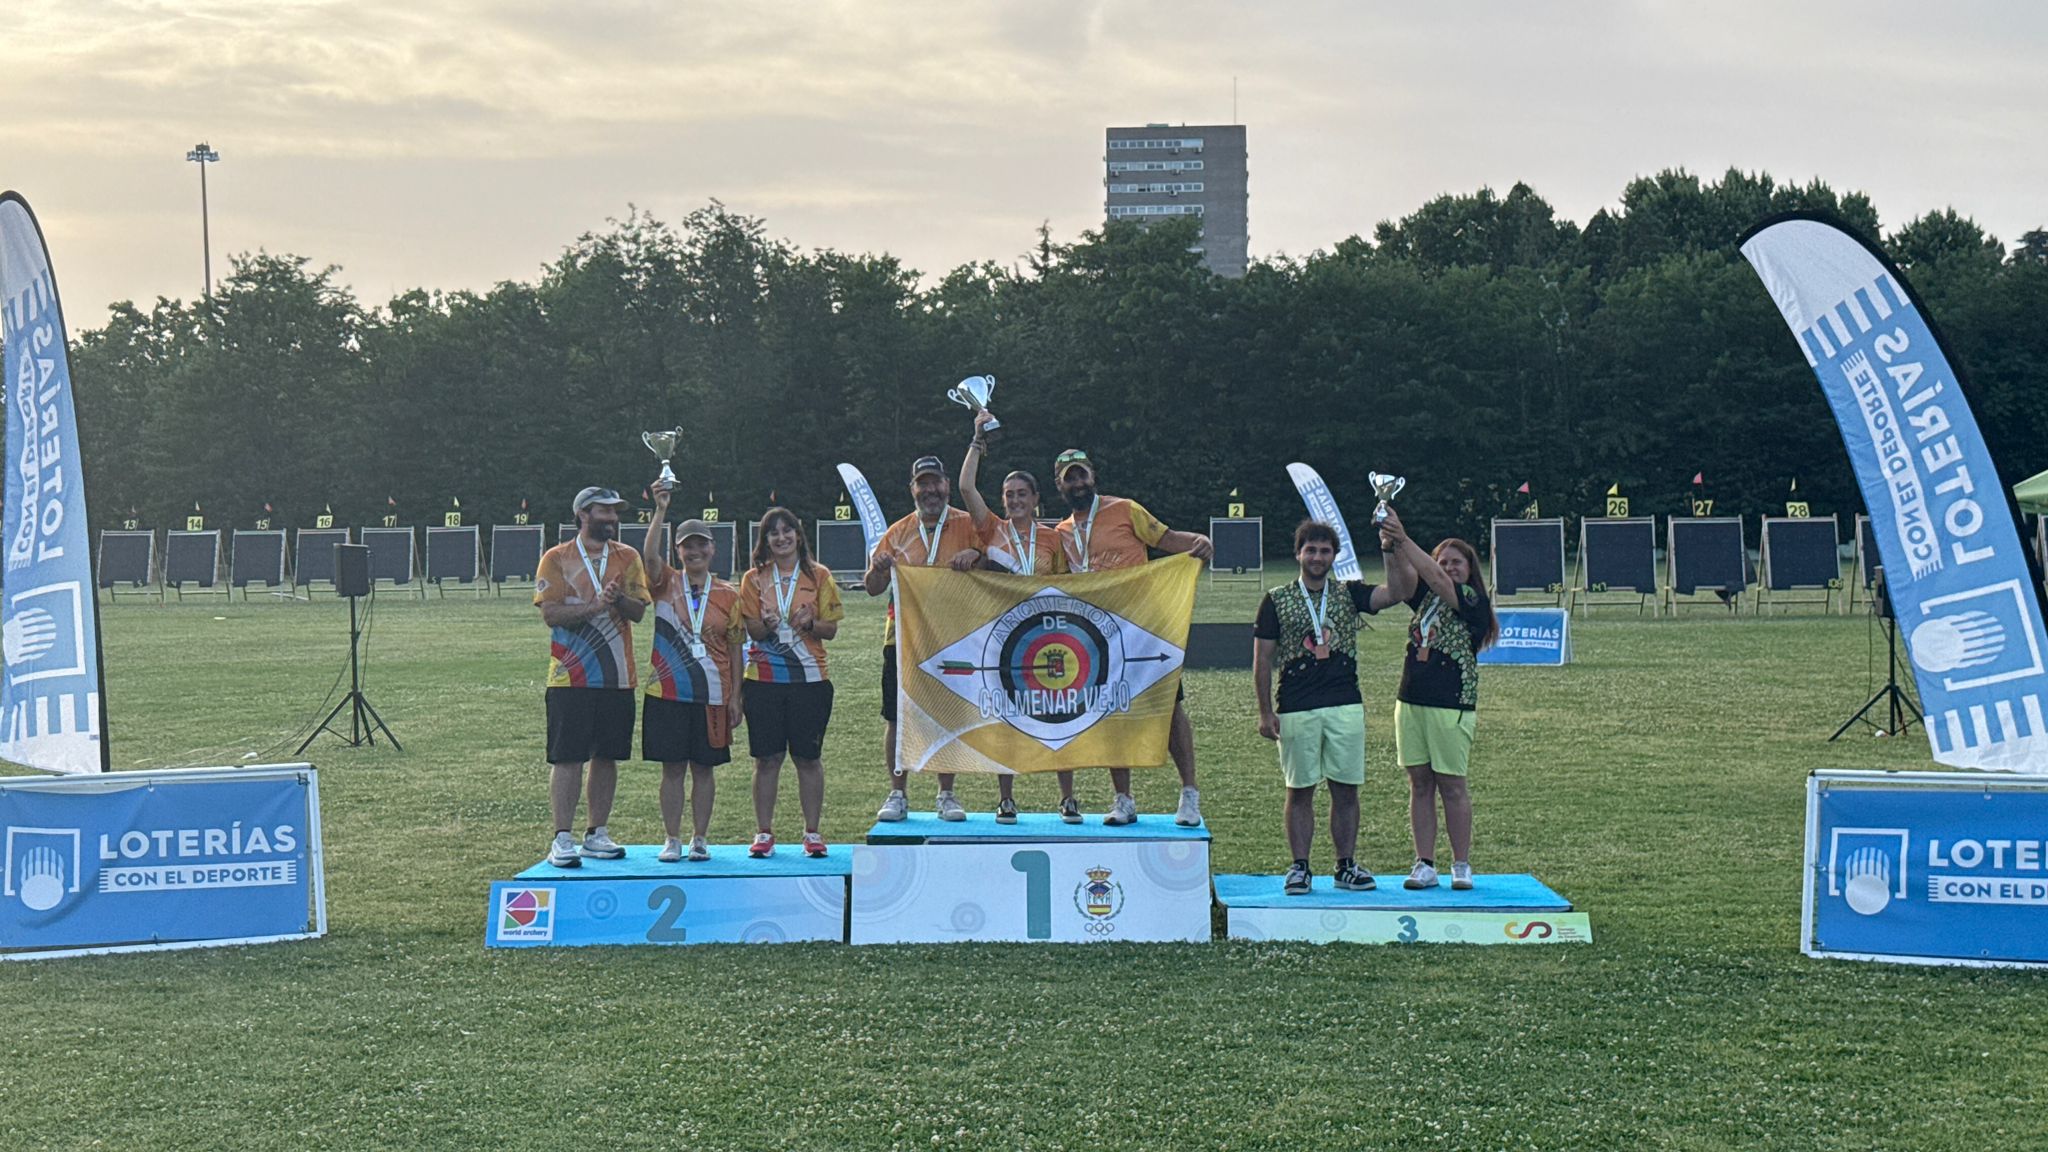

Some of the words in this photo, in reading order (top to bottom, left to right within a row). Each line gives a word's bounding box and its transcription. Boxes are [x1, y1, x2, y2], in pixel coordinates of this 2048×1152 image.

[836, 508, 850, 519] 24
[1608, 501, 1627, 517] 26
[1695, 499, 1714, 516] 27
[1788, 504, 1808, 518] 28
[189, 518, 202, 530] 14
[319, 517, 331, 528] 16
[382, 515, 395, 527] 17
[446, 514, 460, 526] 18
[514, 514, 527, 525] 19
[704, 511, 717, 521] 22
[255, 519, 268, 530] 15
[992, 596, 1119, 646] ARQUEROS
[1043, 615, 1068, 631] DE
[978, 687, 1078, 720] COLMENAR
[1084, 679, 1131, 716] VIEJO
[100, 820, 297, 860] LOTERÍAS
[1928, 838, 2048, 870] LOTE
[114, 870, 158, 887] CON
[165, 870, 187, 885] EL
[192, 865, 282, 884] DEPORTE
[1010, 850, 1052, 940] 1
[1944, 882, 1992, 898] CON
[2000, 884, 2024, 899] EL
[646, 884, 687, 942] 2
[523, 929, 548, 938] archery
[1397, 914, 1419, 943] 3
